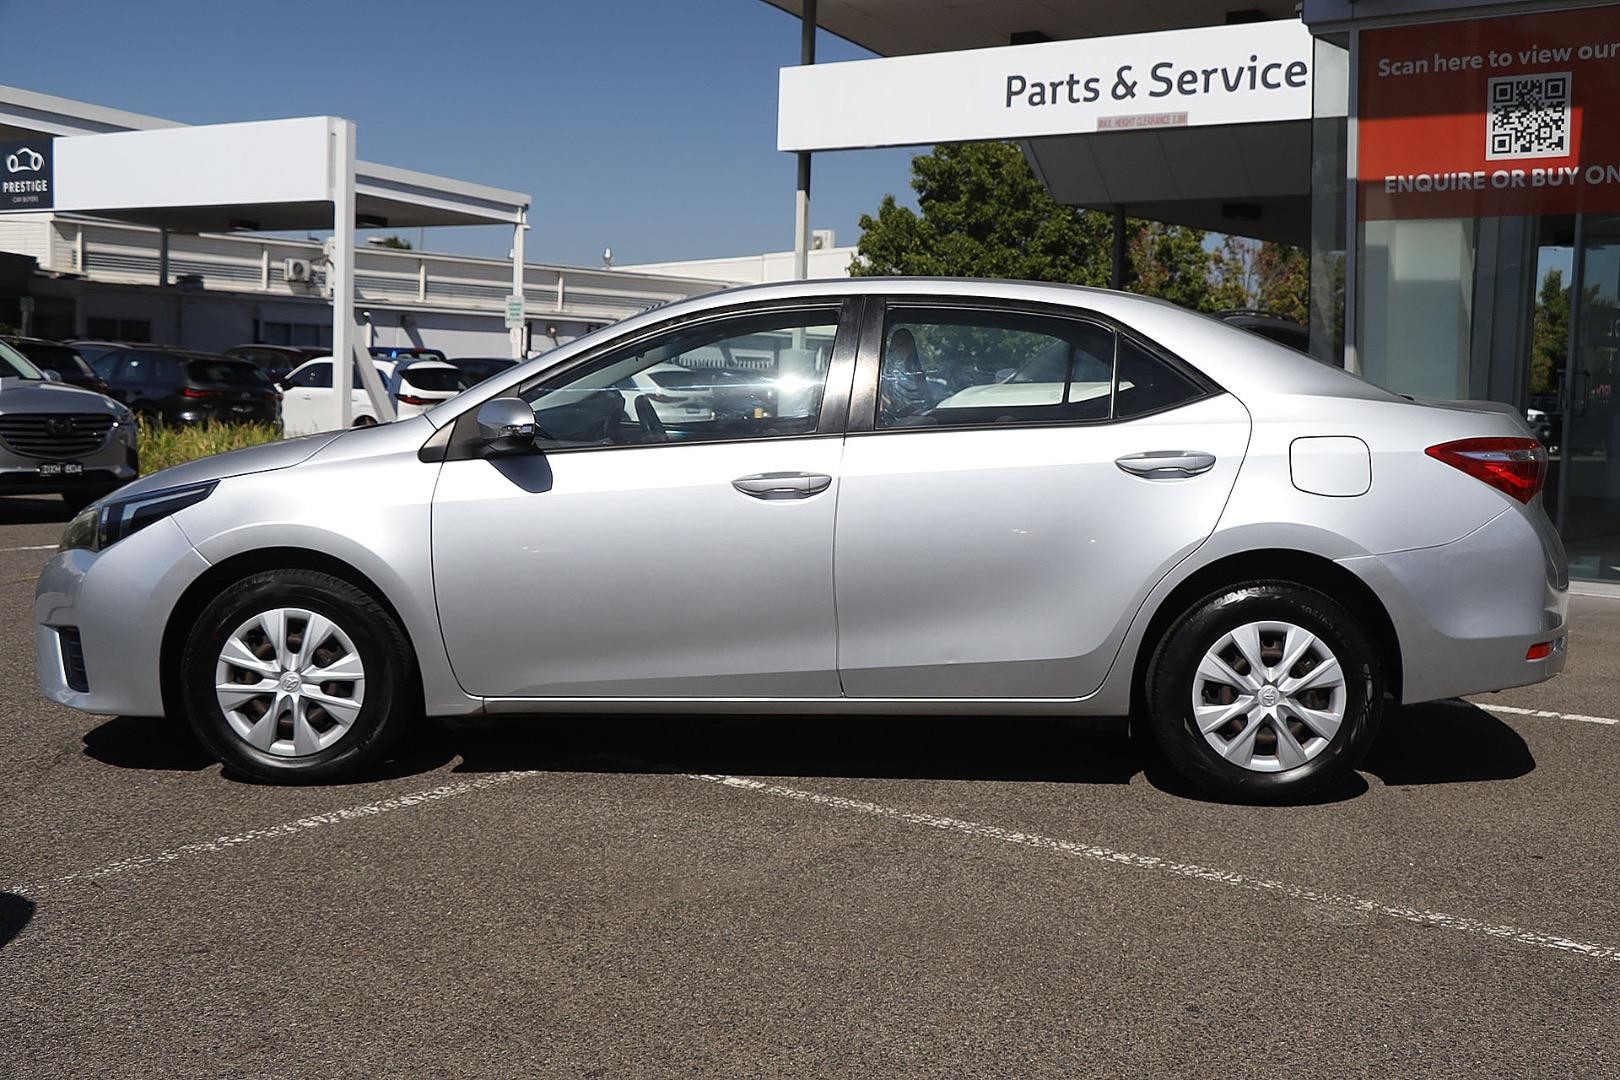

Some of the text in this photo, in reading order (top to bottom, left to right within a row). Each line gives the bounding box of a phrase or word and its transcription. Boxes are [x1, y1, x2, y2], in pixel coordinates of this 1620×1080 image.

[1378, 43, 1620, 77] Scan here to view our
[1006, 54, 1307, 107] Parts & Service
[3, 180, 48, 192] PRESTIGE
[1384, 164, 1620, 193] ENQUIRE OR BUY ON
